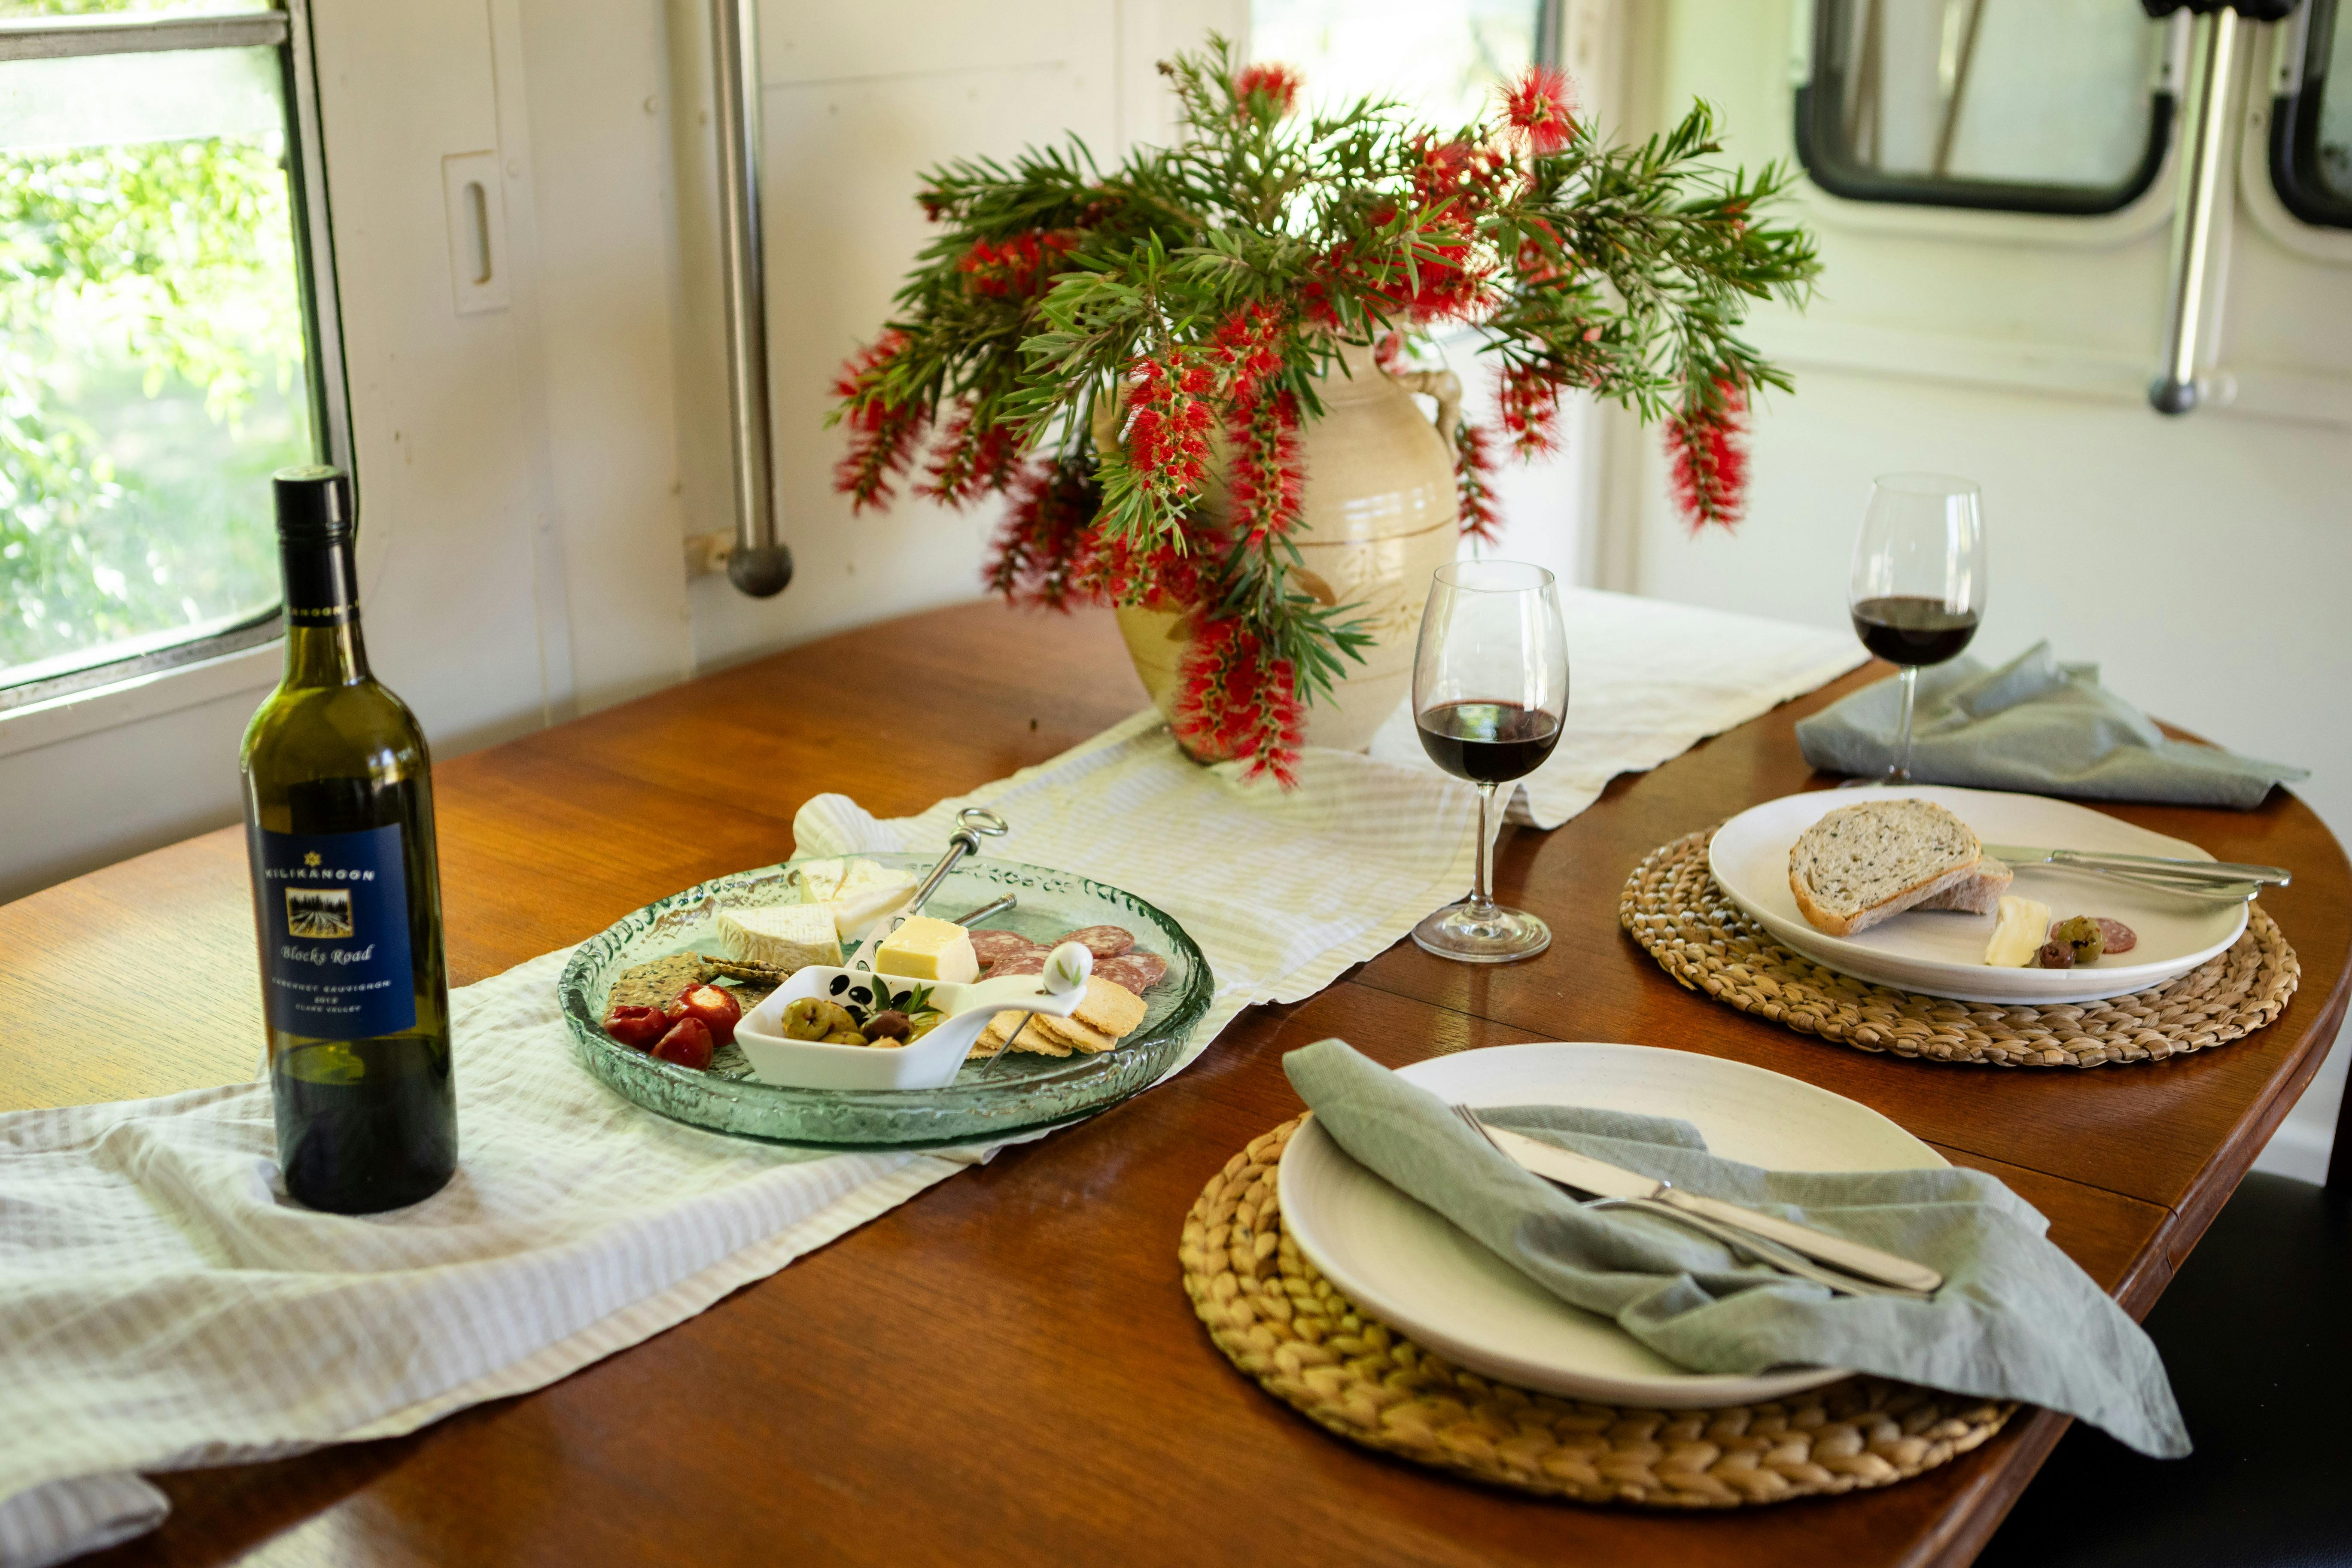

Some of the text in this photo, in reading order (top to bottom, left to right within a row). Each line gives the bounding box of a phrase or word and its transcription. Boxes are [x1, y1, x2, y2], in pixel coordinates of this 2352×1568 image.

[265, 868, 375, 880] KILIKANOON
[281, 944, 375, 965] Blocks Road
[272, 977, 391, 993] CABERNET SAUVIGNON
[326, 1005, 361, 1013] VALLEY
